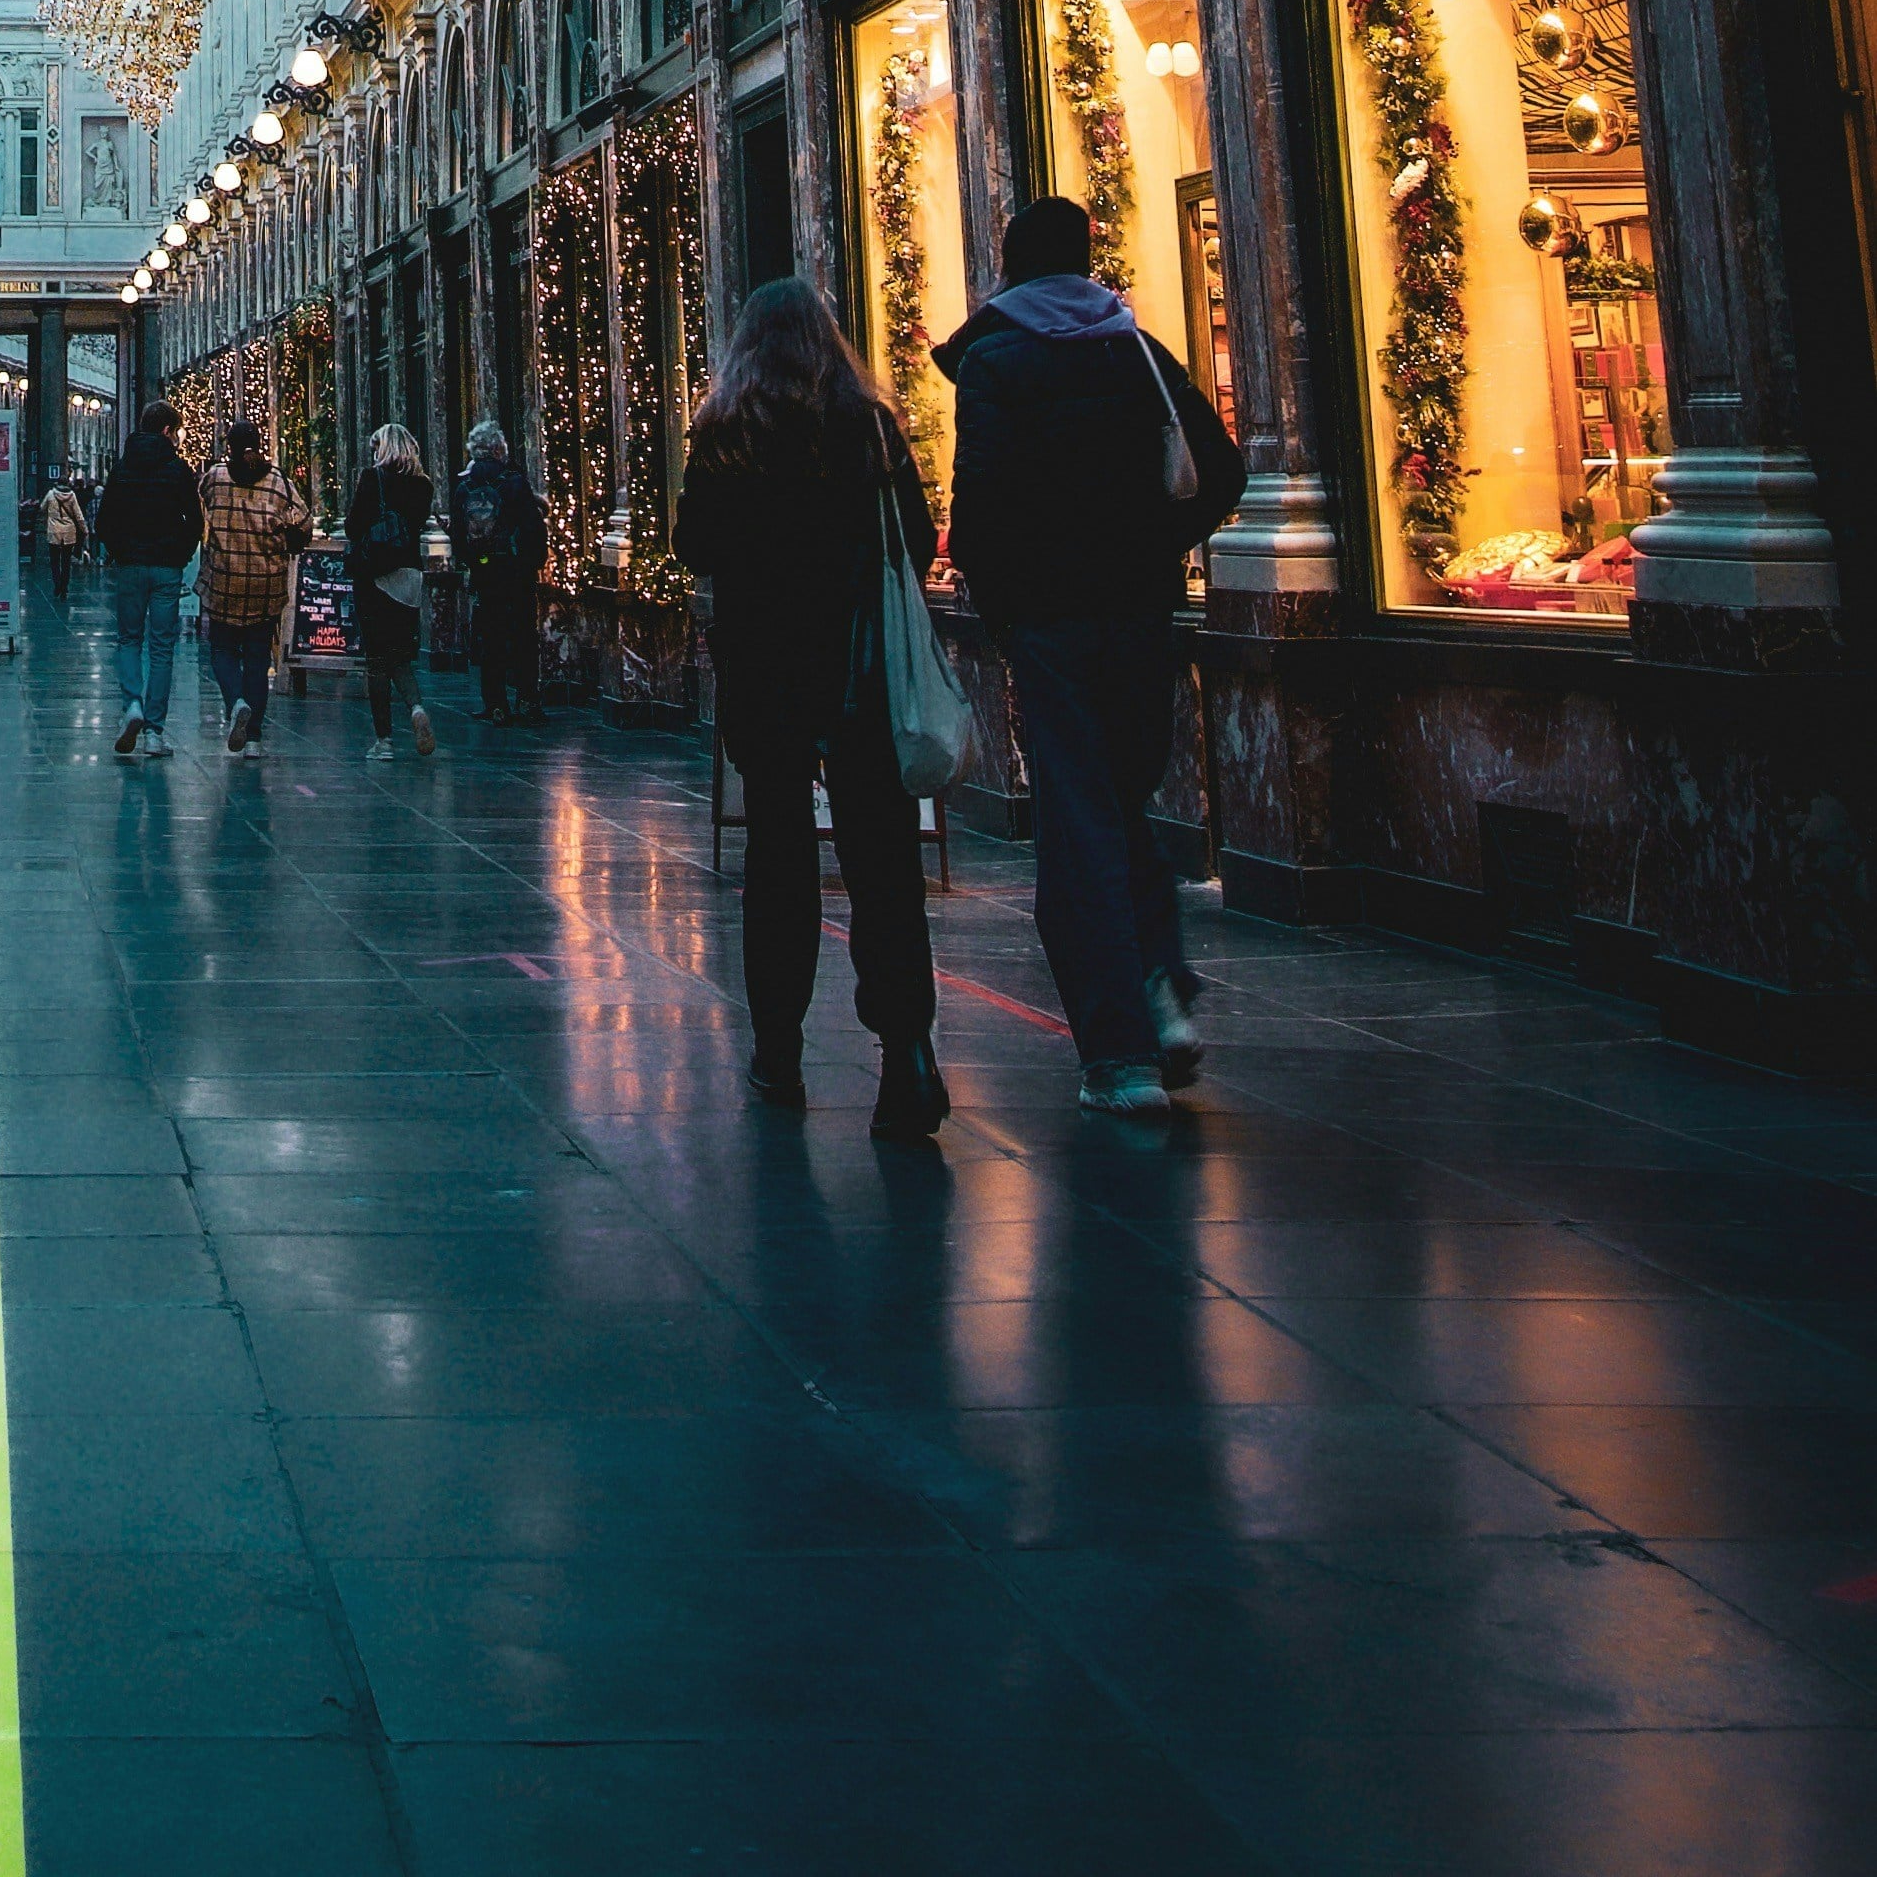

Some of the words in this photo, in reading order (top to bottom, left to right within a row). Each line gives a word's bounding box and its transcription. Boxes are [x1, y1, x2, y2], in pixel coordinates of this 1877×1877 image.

[0, 281, 40, 292] REINE
[316, 626, 341, 636] HAPPY
[308, 636, 347, 648] HOLIDAYS
